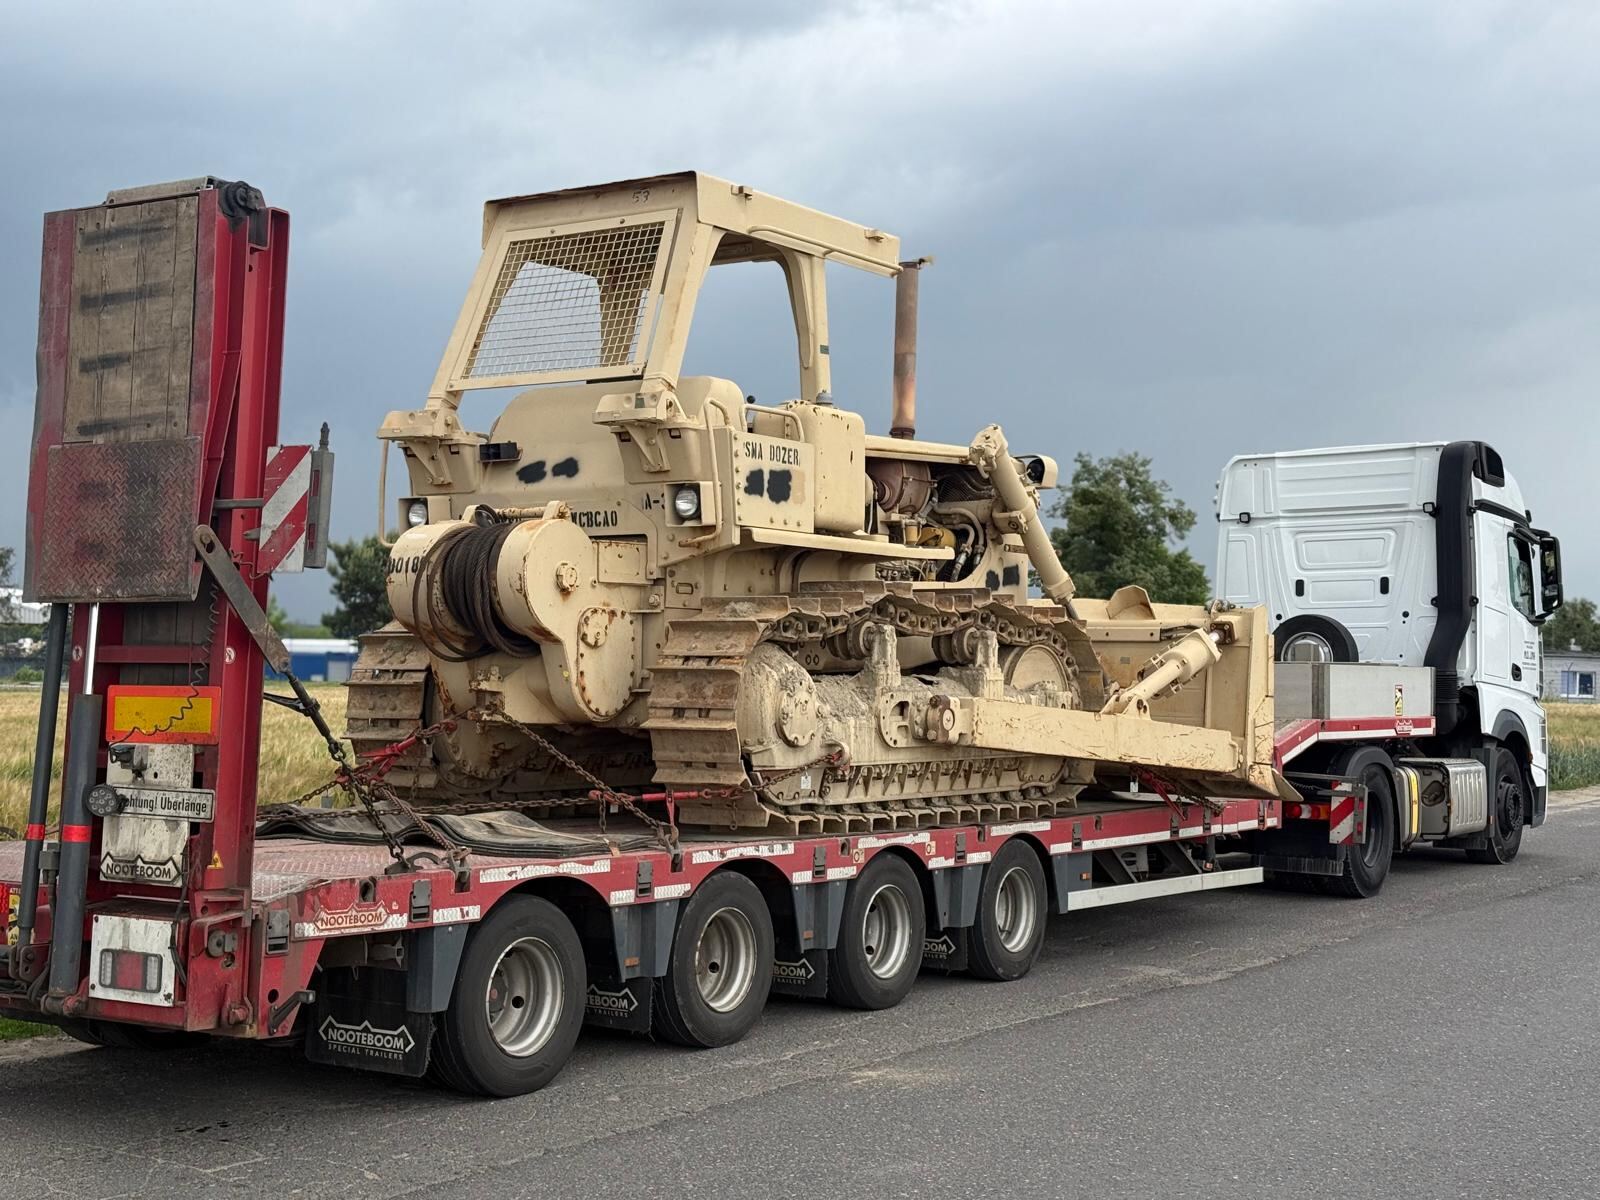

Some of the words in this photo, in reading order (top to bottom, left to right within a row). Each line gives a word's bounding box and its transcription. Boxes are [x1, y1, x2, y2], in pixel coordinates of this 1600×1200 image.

[769, 444, 800, 467] DOZER
[124, 794, 158, 813] chtung!
[160, 793, 207, 816] Überlänge
[105, 862, 172, 880] NOOTEBOOM
[320, 911, 383, 928] NOOTEBOOM
[327, 1027, 405, 1051] NOOTEBOOM
[328, 1042, 361, 1056] SPECIAL
[365, 1048, 403, 1061] TRAILERS
